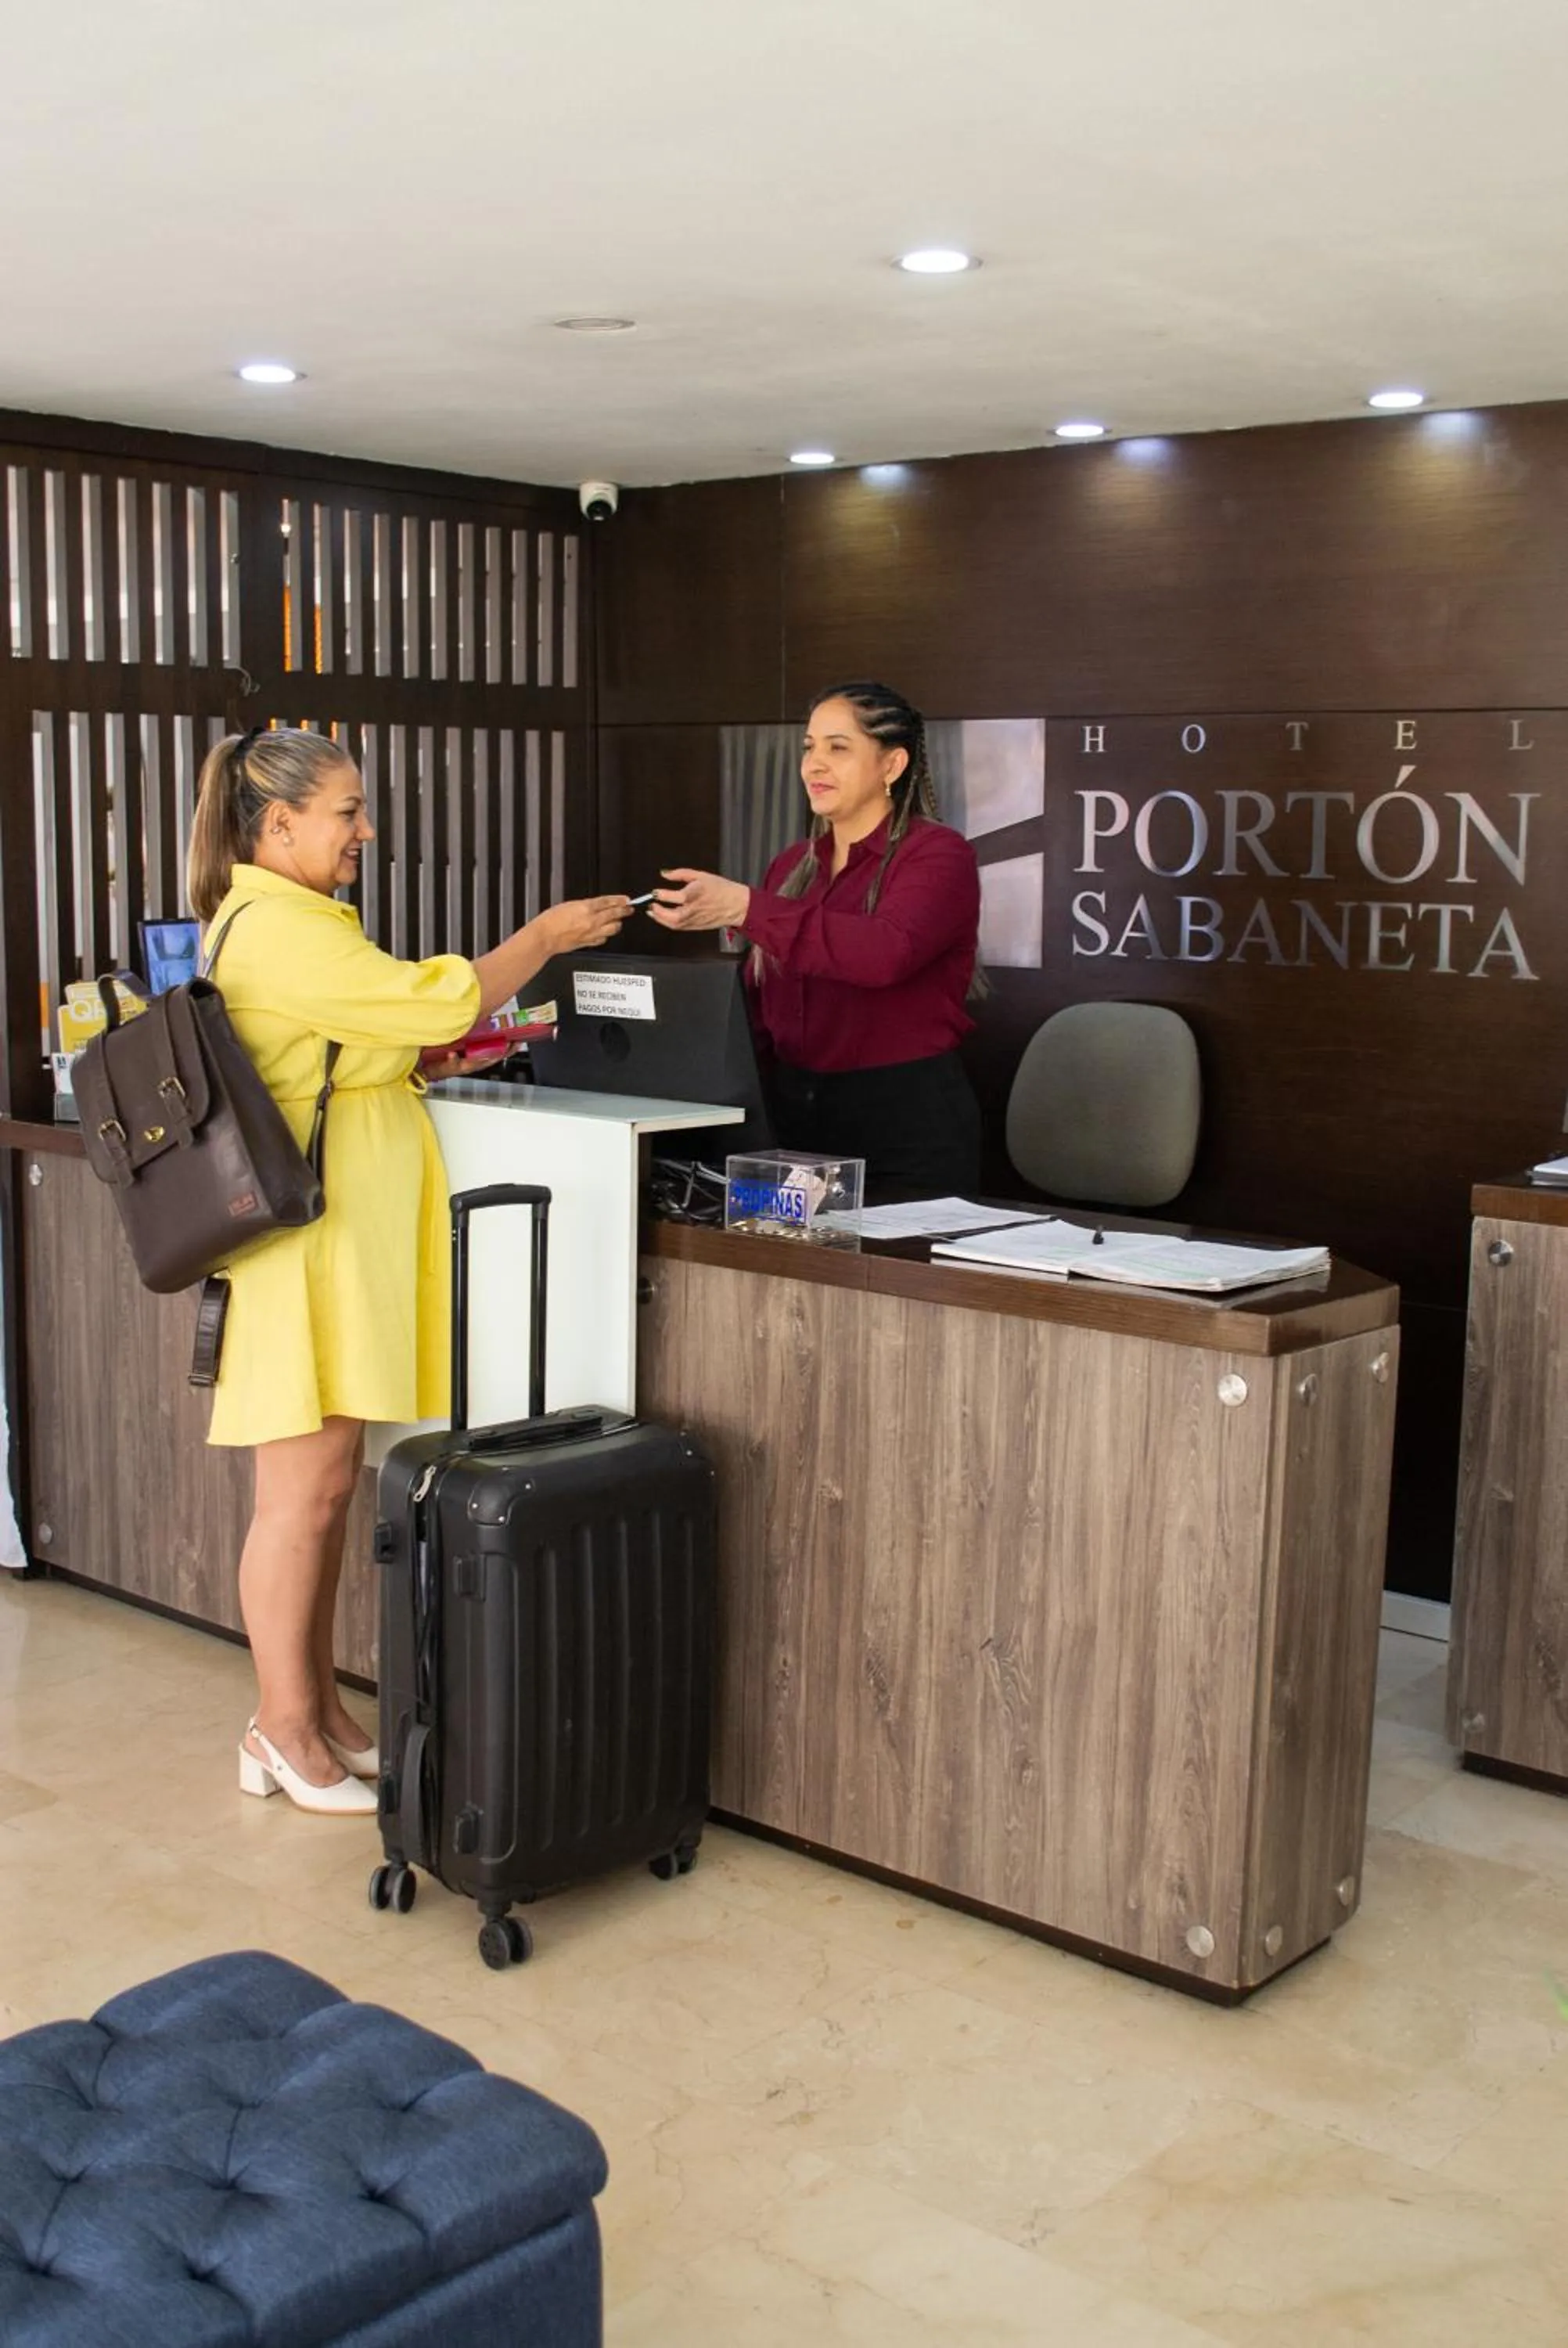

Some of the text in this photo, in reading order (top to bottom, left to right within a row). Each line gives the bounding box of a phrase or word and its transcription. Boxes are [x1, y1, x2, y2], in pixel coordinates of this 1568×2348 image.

[1082, 719, 1534, 753] HOTEL
[1073, 764, 1541, 887] PORTÓN
[1070, 890, 1541, 981] SABANETA
[578, 1003, 601, 1013] PAGOS
[602, 1005, 616, 1014] POR
